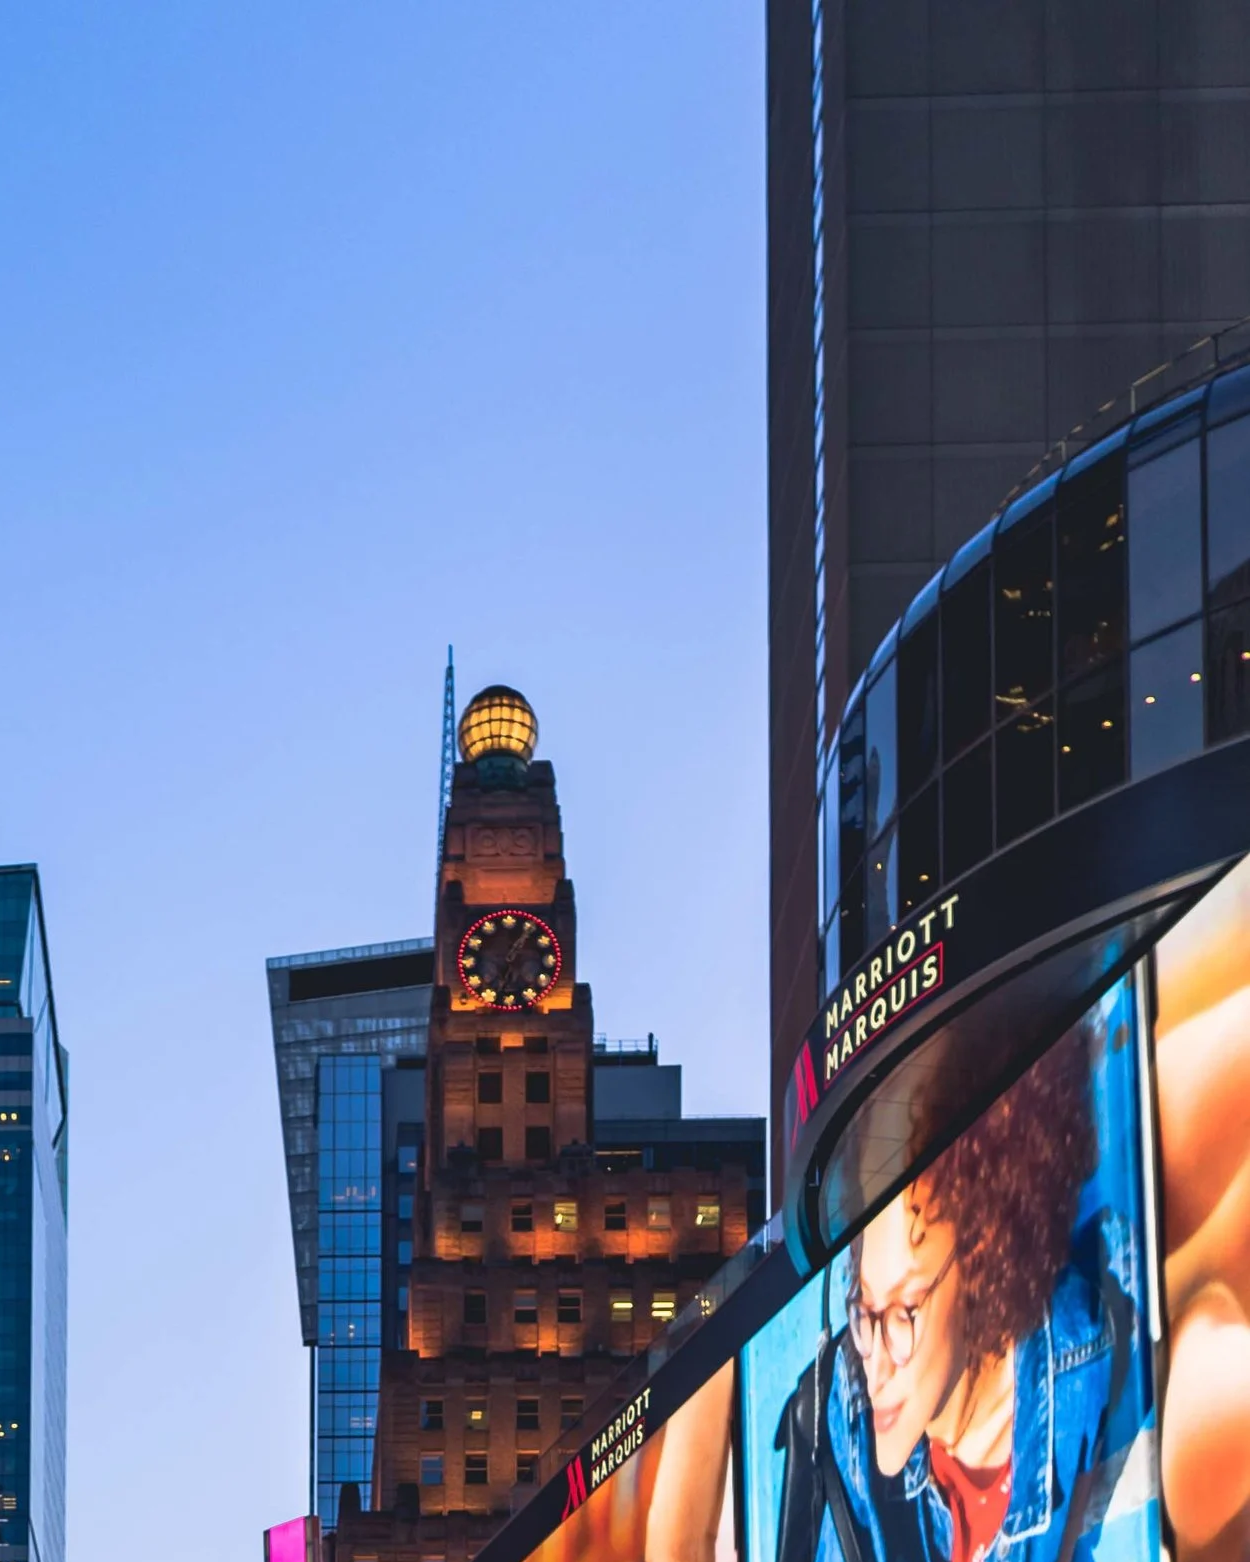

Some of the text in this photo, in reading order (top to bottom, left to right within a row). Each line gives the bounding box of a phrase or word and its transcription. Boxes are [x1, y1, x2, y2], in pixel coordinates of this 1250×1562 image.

[825, 894, 961, 1040] MARRIOTT
[825, 955, 939, 1082] MARQUIS
[591, 1387, 652, 1462] MARRIOTT
[591, 1425, 645, 1489] MARQUIS
